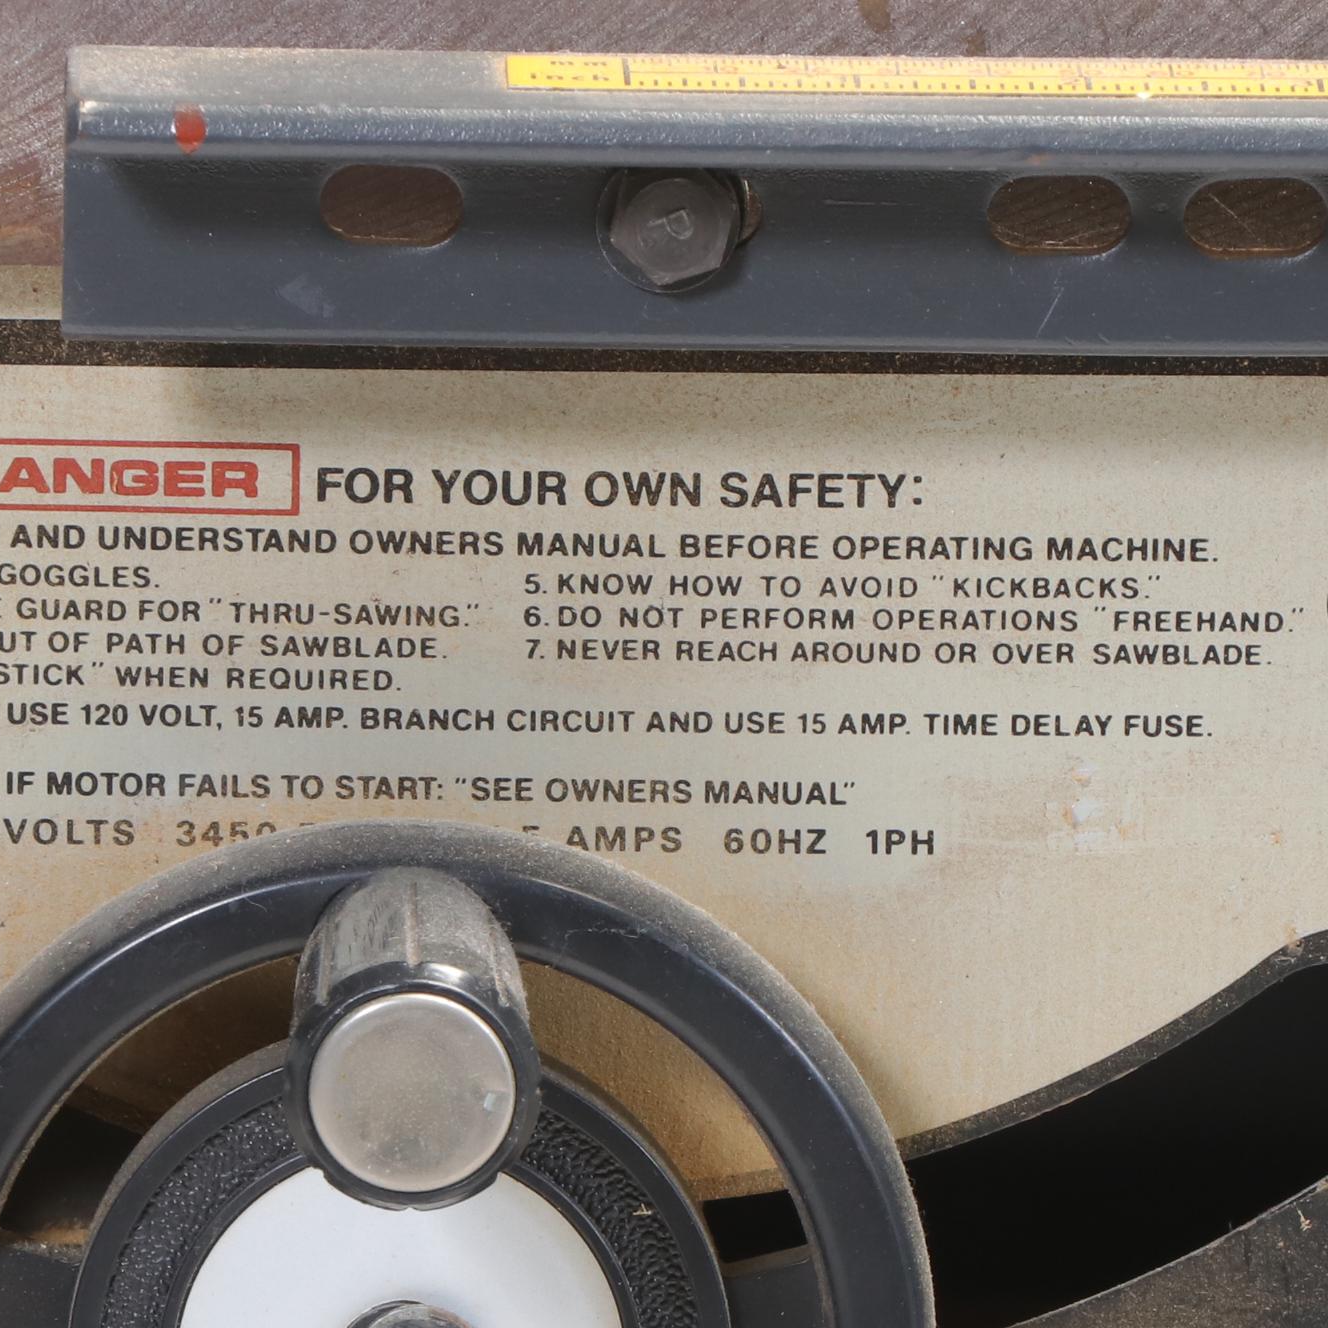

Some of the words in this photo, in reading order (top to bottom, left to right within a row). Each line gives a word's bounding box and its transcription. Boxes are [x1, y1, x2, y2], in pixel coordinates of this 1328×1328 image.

[317, 467, 414, 504] FOR
[432, 469, 567, 507] YOUR
[585, 470, 701, 508] OWN
[719, 471, 924, 509] SAFETY:
[10, 524, 86, 550] AND
[98, 525, 337, 554] UNDERSTAND
[349, 529, 504, 557] OWNERS
[517, 531, 667, 559] MANUAL
[679, 533, 819, 560] BEFORE
[832, 535, 1033, 562] OPERATING
[1046, 537, 1219, 563] MACHINE.
[524, 573, 548, 595] 5.
[557, 573, 654, 596] KNOW
[669, 575, 742, 598] HOW
[759, 576, 802, 598] TO
[819, 576, 918, 598] AVOID
[931, 575, 1162, 600] "KICKBACKS."
[15, 598, 127, 622] GUARD
[138, 600, 201, 623] FOR
[208, 598, 480, 628] "THRU-SAWING."
[523, 605, 549, 628] 6.
[558, 605, 602, 628] DO
[619, 605, 684, 628] NOT
[700, 607, 855, 630] PERFORM
[872, 608, 1078, 632] OPERATIONS
[1093, 606, 1305, 633] "FREEHAND."
[47, 630, 90, 653] OF
[106, 632, 185, 655] PATH
[201, 633, 245, 657] OF
[260, 634, 449, 659] SAWBLADE.
[525, 638, 545, 660] 7.
[557, 638, 661, 661] NEVER
[675, 640, 778, 663] REACH
[790, 641, 921, 664] AROUND
[934, 642, 977, 665] OR
[992, 643, 1075, 665] OVER
[1092, 643, 1273, 666] SAWBLADE.
[114, 665, 209, 689] WHEN
[226, 667, 402, 692] REQUIRED.
[7, 702, 70, 726] USE
[81, 704, 129, 727] 120
[139, 704, 223, 731] VOLT,
[235, 705, 264, 728] 15
[274, 706, 349, 729] AMP.
[360, 708, 495, 732] BRANCH
[506, 709, 636, 733] CIRCUIT
[645, 711, 713, 734] AND
[724, 711, 786, 735] USE
[797, 712, 827, 735] 15
[837, 712, 911, 736] AMP.
[922, 713, 999, 737] TIME
[1010, 714, 1113, 738] DELAY
[1123, 715, 1214, 738] FUSE.
[7, 771, 35, 795] IF
[46, 772, 166, 797] MOTOR
[178, 773, 271, 799] FAILS
[281, 774, 324, 799] TO
[335, 775, 444, 801] START:
[454, 776, 534, 802] "SEE
[544, 777, 693, 804] OWNERS
[704, 780, 857, 806] MANUAL"
[2, 818, 136, 846] VOLTS
[565, 825, 682, 853] AMPS
[723, 827, 827, 855] 60HZ
[865, 829, 935, 856] 1PH
